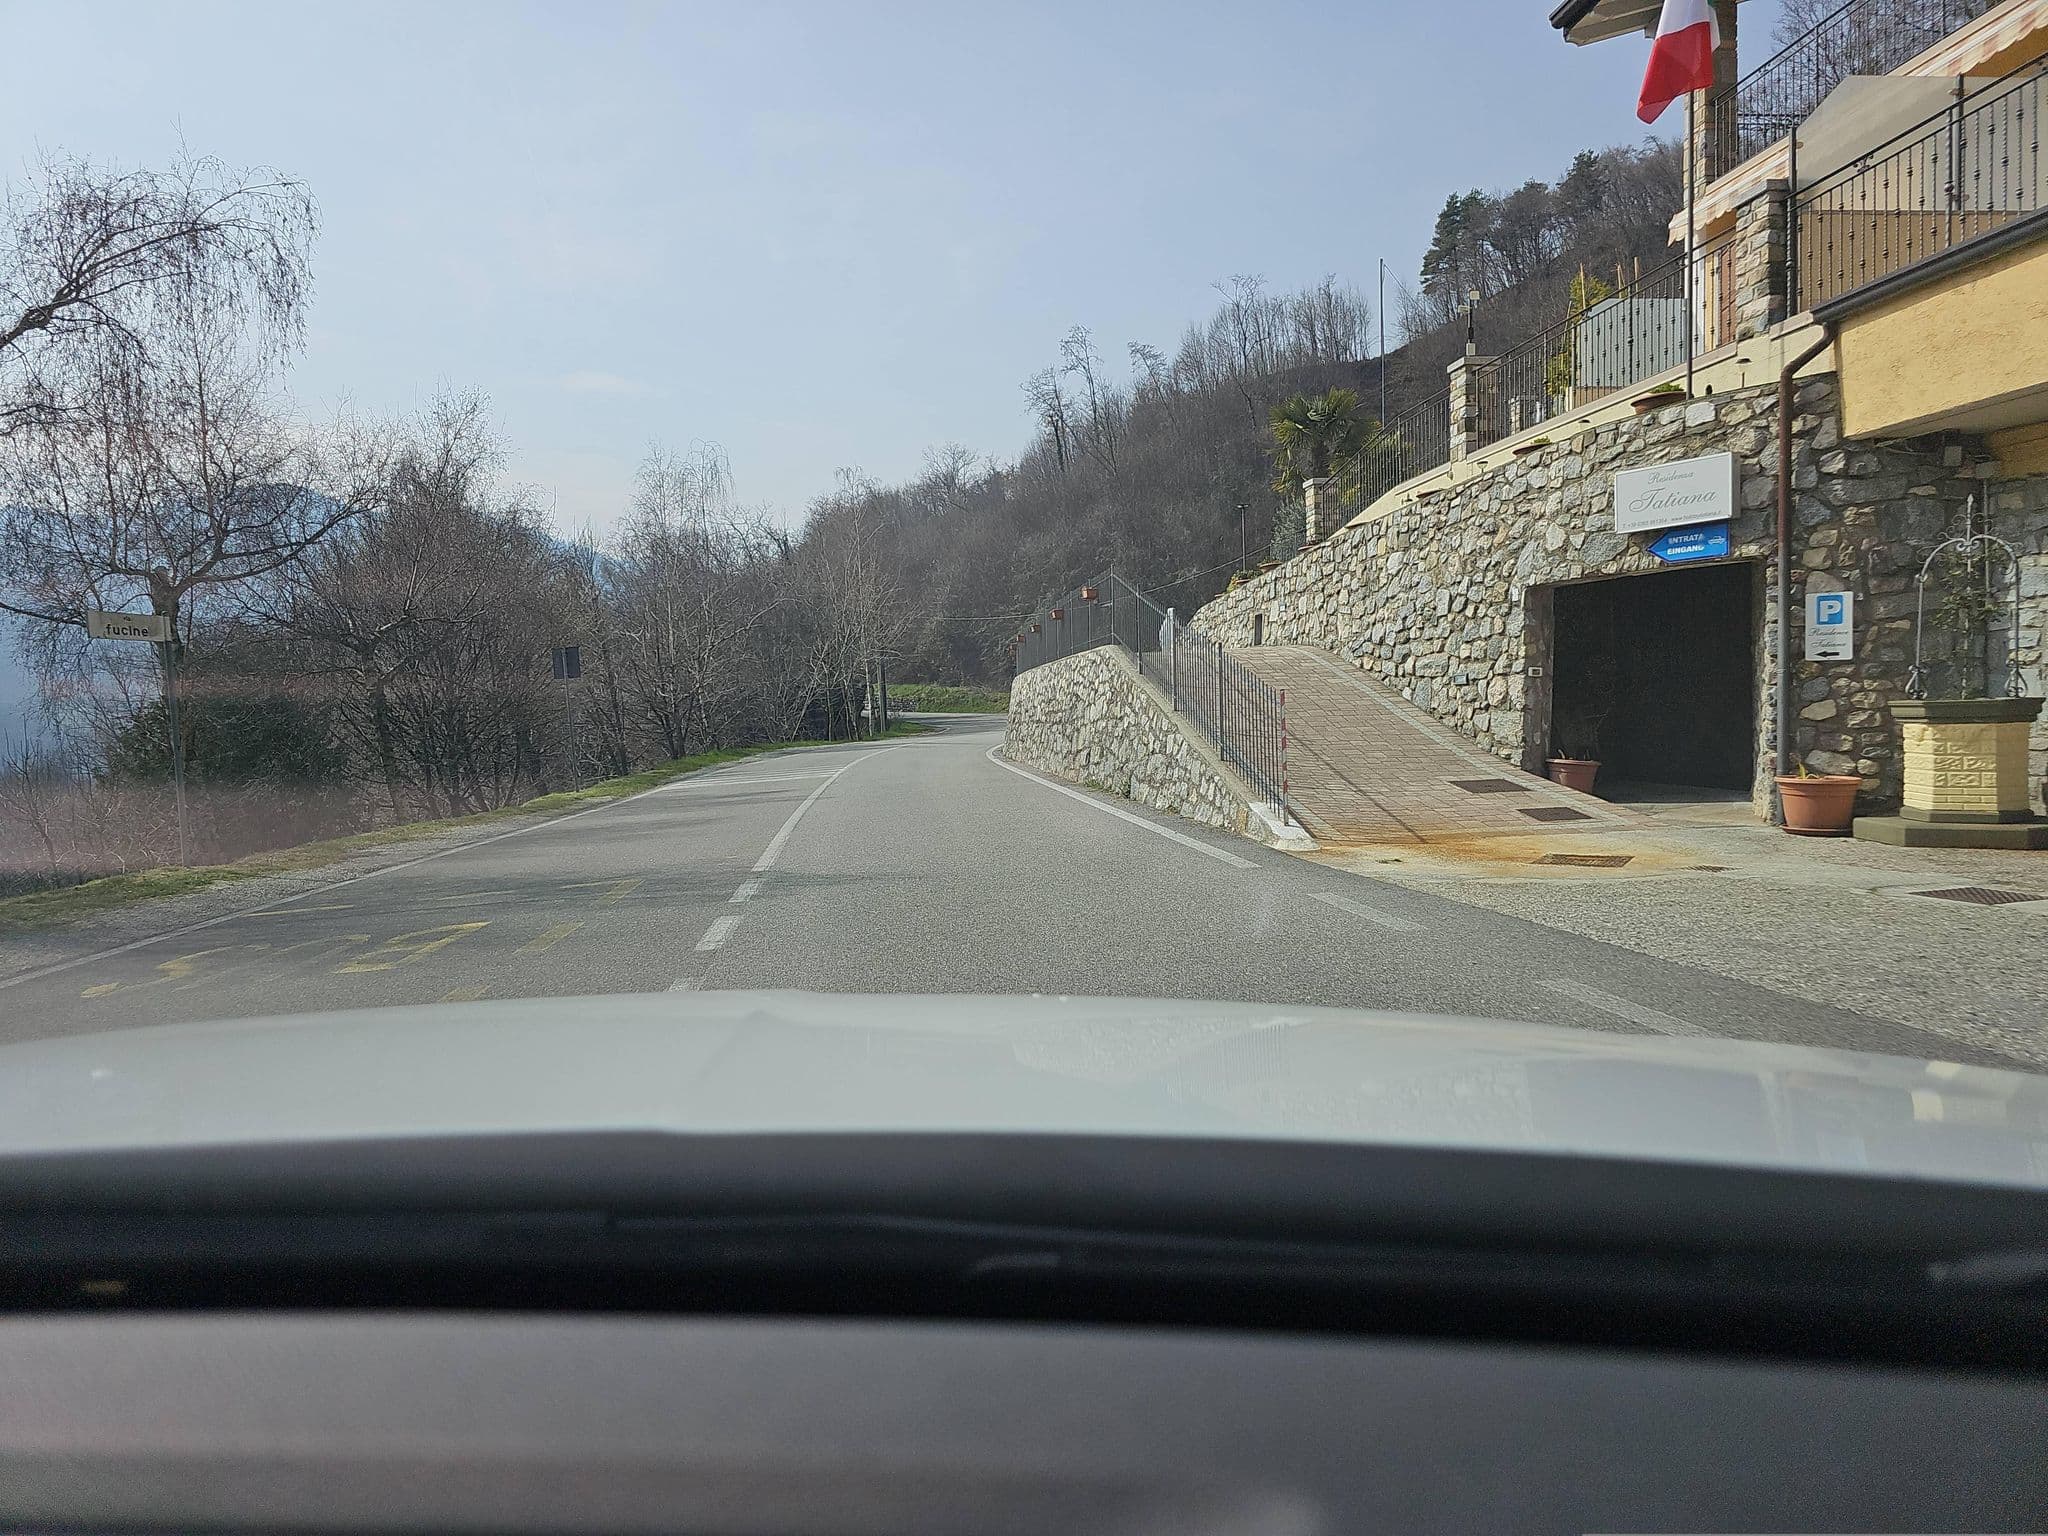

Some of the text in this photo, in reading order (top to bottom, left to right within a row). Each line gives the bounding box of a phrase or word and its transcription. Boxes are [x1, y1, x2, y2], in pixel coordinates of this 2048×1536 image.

[1628, 487, 1717, 513] Tatiana
[1820, 600, 1841, 622] P
[105, 623, 149, 637] fucine
